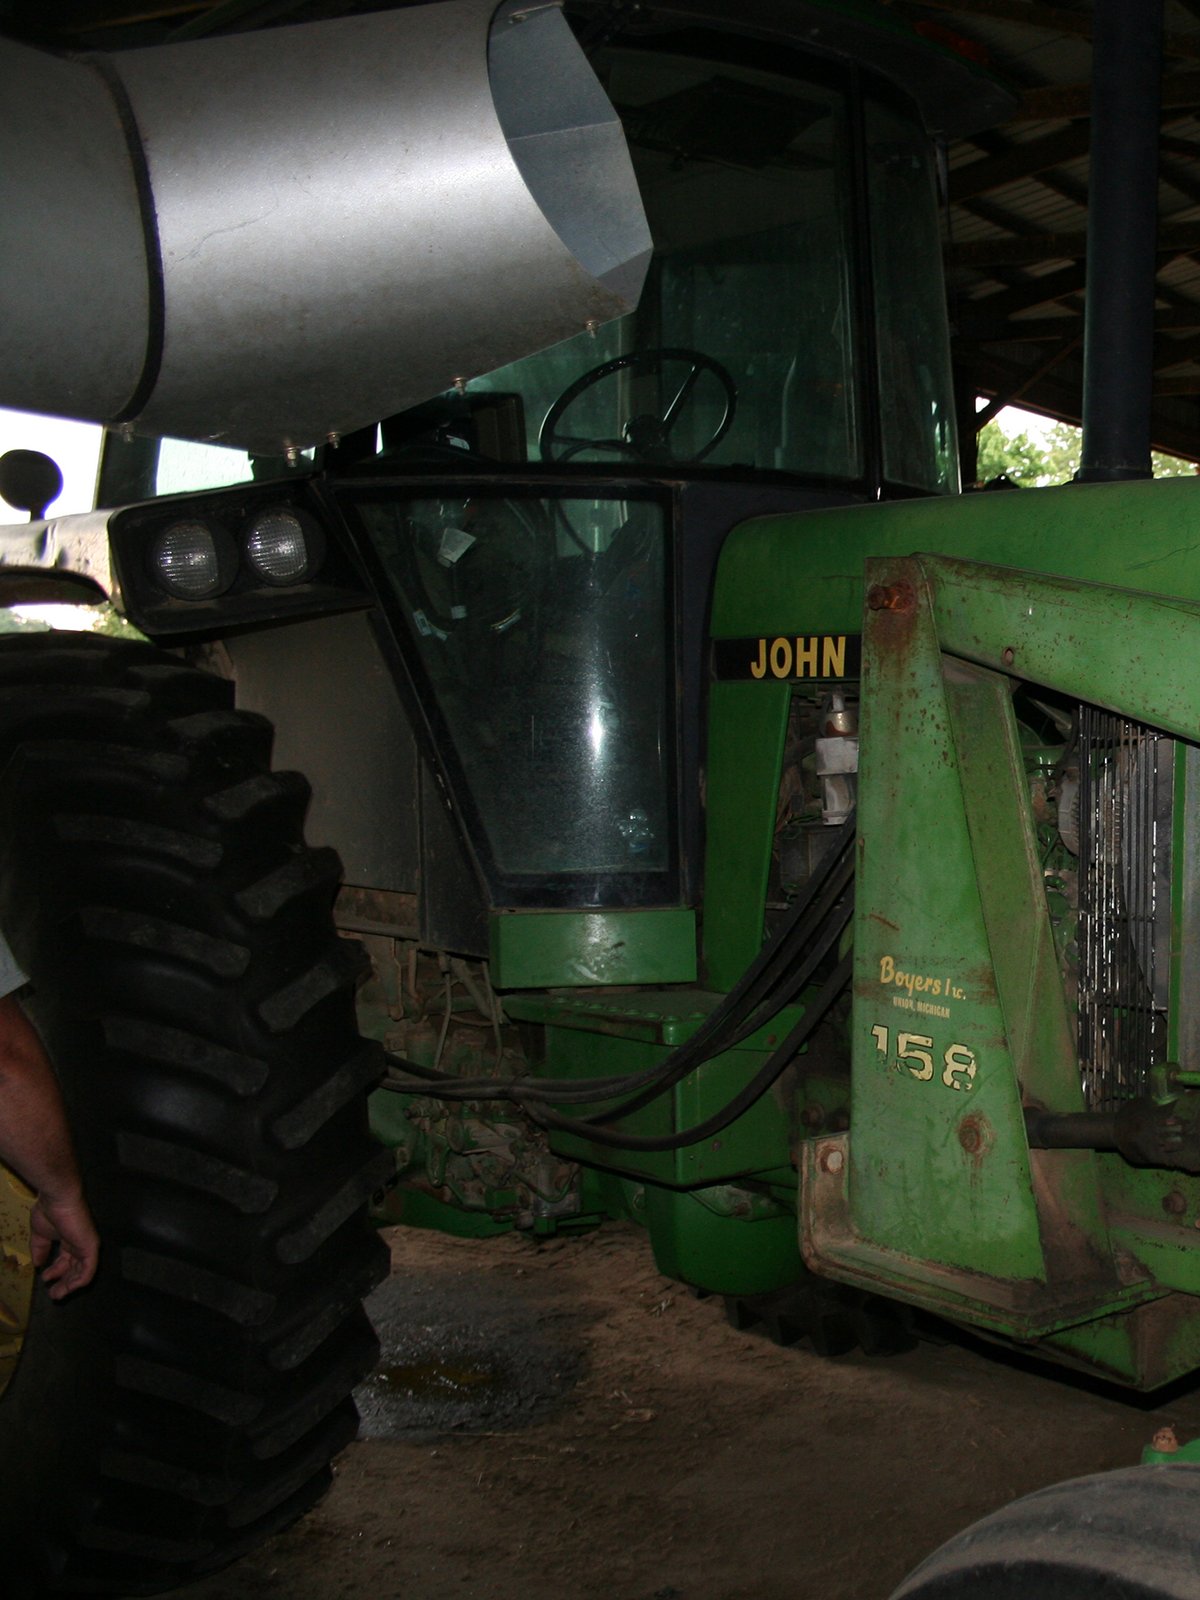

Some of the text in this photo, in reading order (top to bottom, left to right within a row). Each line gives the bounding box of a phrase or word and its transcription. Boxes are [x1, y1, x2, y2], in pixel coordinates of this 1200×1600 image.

[751, 636, 846, 679] JOHN
[880, 955, 942, 997] Boyers
[917, 1001, 951, 1018] MICHIGAN
[871, 1024, 977, 1091] 158
